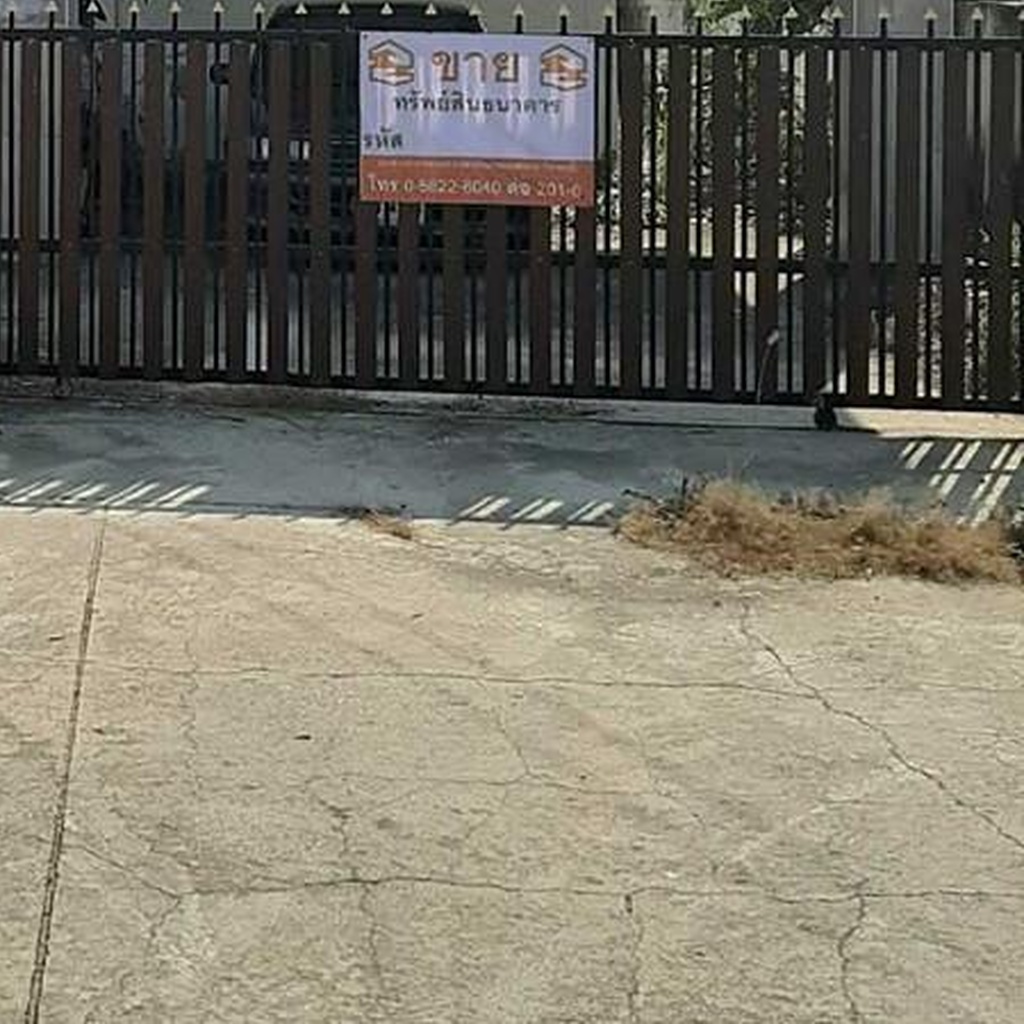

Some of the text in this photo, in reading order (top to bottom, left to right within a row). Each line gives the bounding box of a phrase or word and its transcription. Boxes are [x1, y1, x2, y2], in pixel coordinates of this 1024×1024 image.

[432, 49, 520, 84] ขาย
[393, 90, 562, 114] ทรัพย์สินธนาคาร
[362, 128, 404, 150] รหัส
